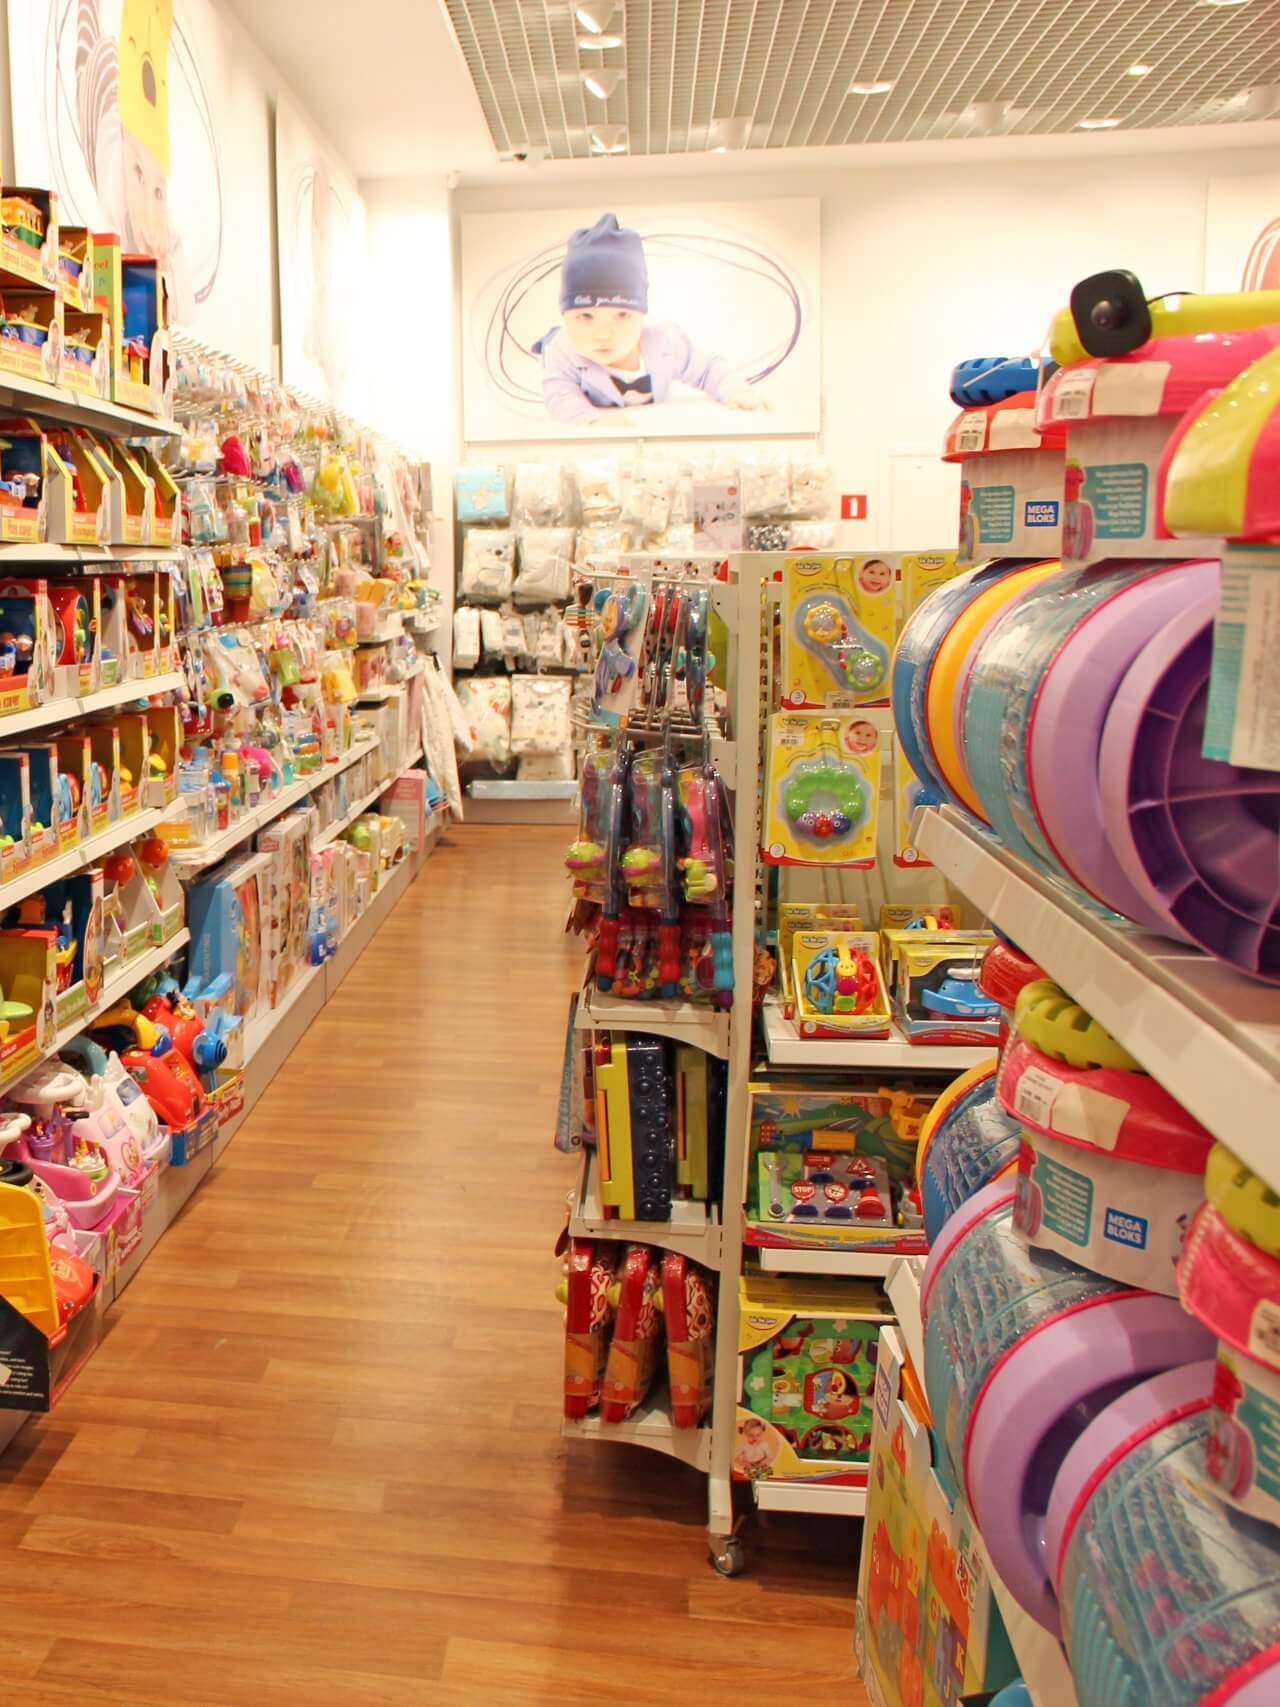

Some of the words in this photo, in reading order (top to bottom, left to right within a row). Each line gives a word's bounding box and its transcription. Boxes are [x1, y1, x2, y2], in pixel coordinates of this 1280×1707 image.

[1028, 504, 1055, 515] MEGA
[1027, 514, 1056, 524] BLOKS
[793, 1183, 815, 1196] STOP
[1107, 1214, 1142, 1232] MEGA
[1107, 1224, 1142, 1245] BLOKS
